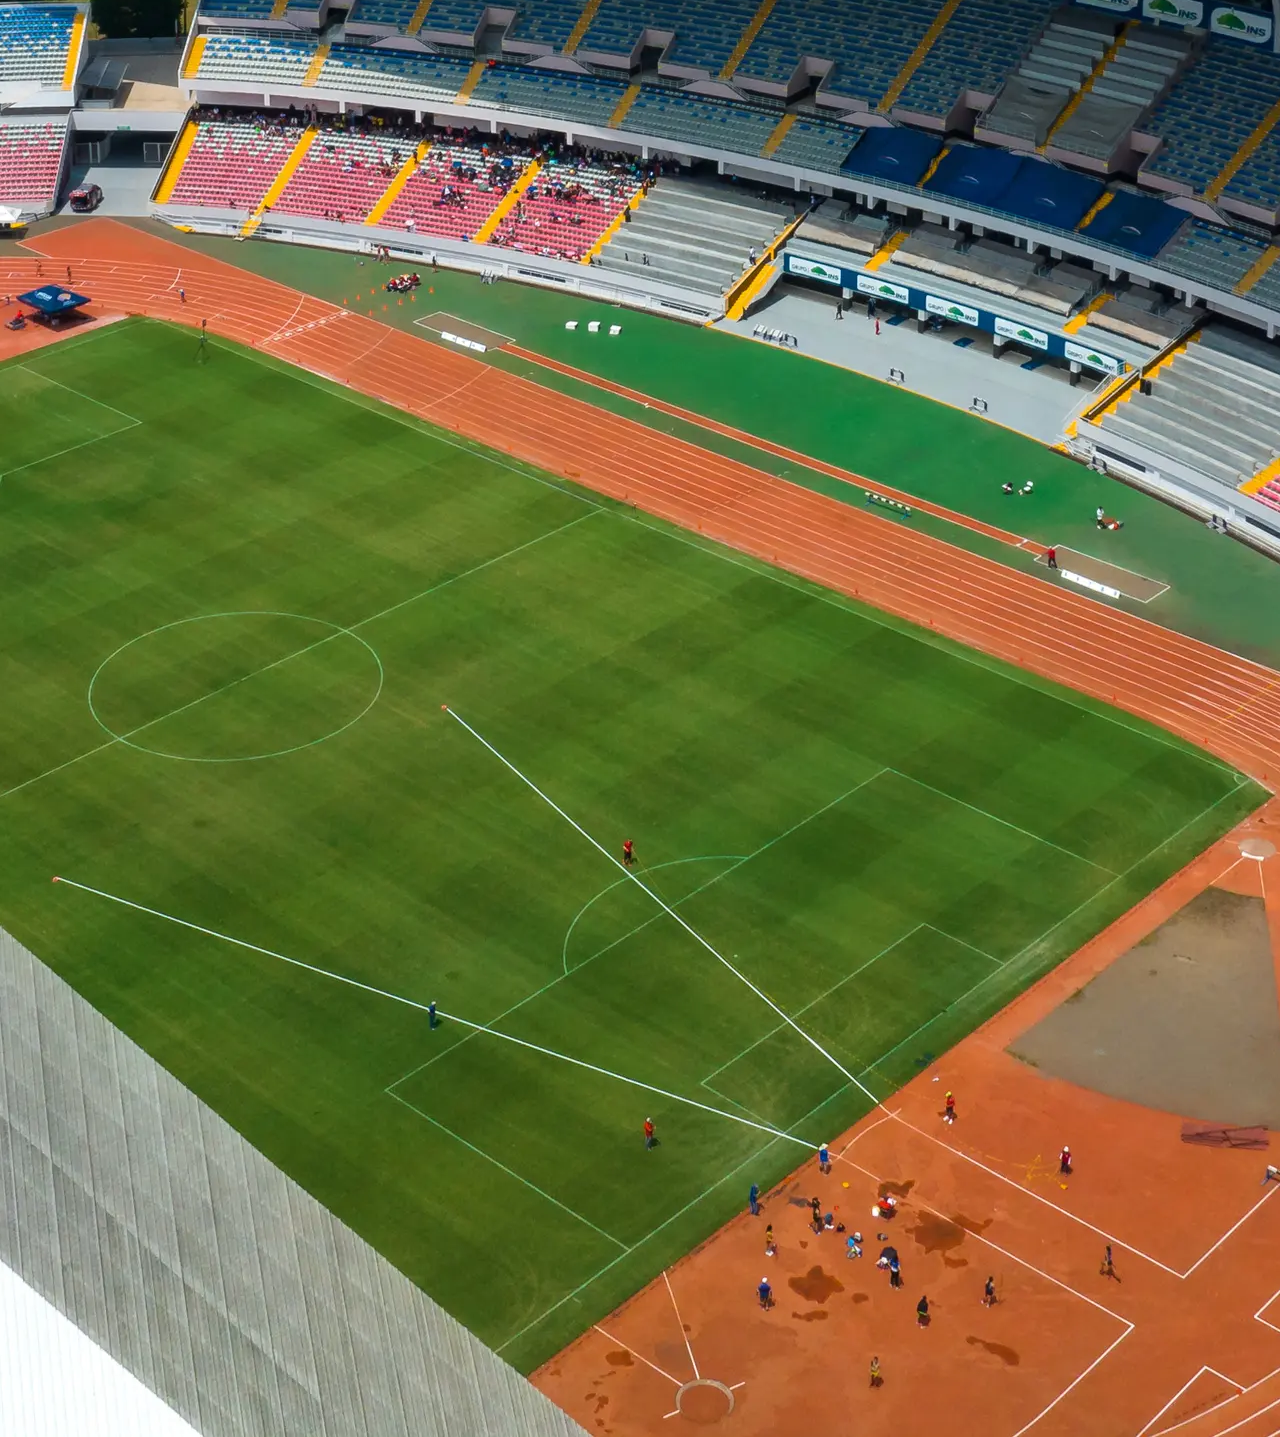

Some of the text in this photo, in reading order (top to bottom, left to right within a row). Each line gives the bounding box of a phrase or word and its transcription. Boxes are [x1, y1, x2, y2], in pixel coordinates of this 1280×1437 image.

[1178, 9, 1198, 21] INS
[1246, 25, 1266, 37] INS
[791, 264, 839, 281] GRUPO INS
[859, 282, 907, 301] GRUPO INS
[927, 303, 944, 312] GRUPO
[964, 314, 977, 323] INS
[996, 326, 1046, 346] GRUPO INS
[1066, 350, 1083, 359] GRUPO
